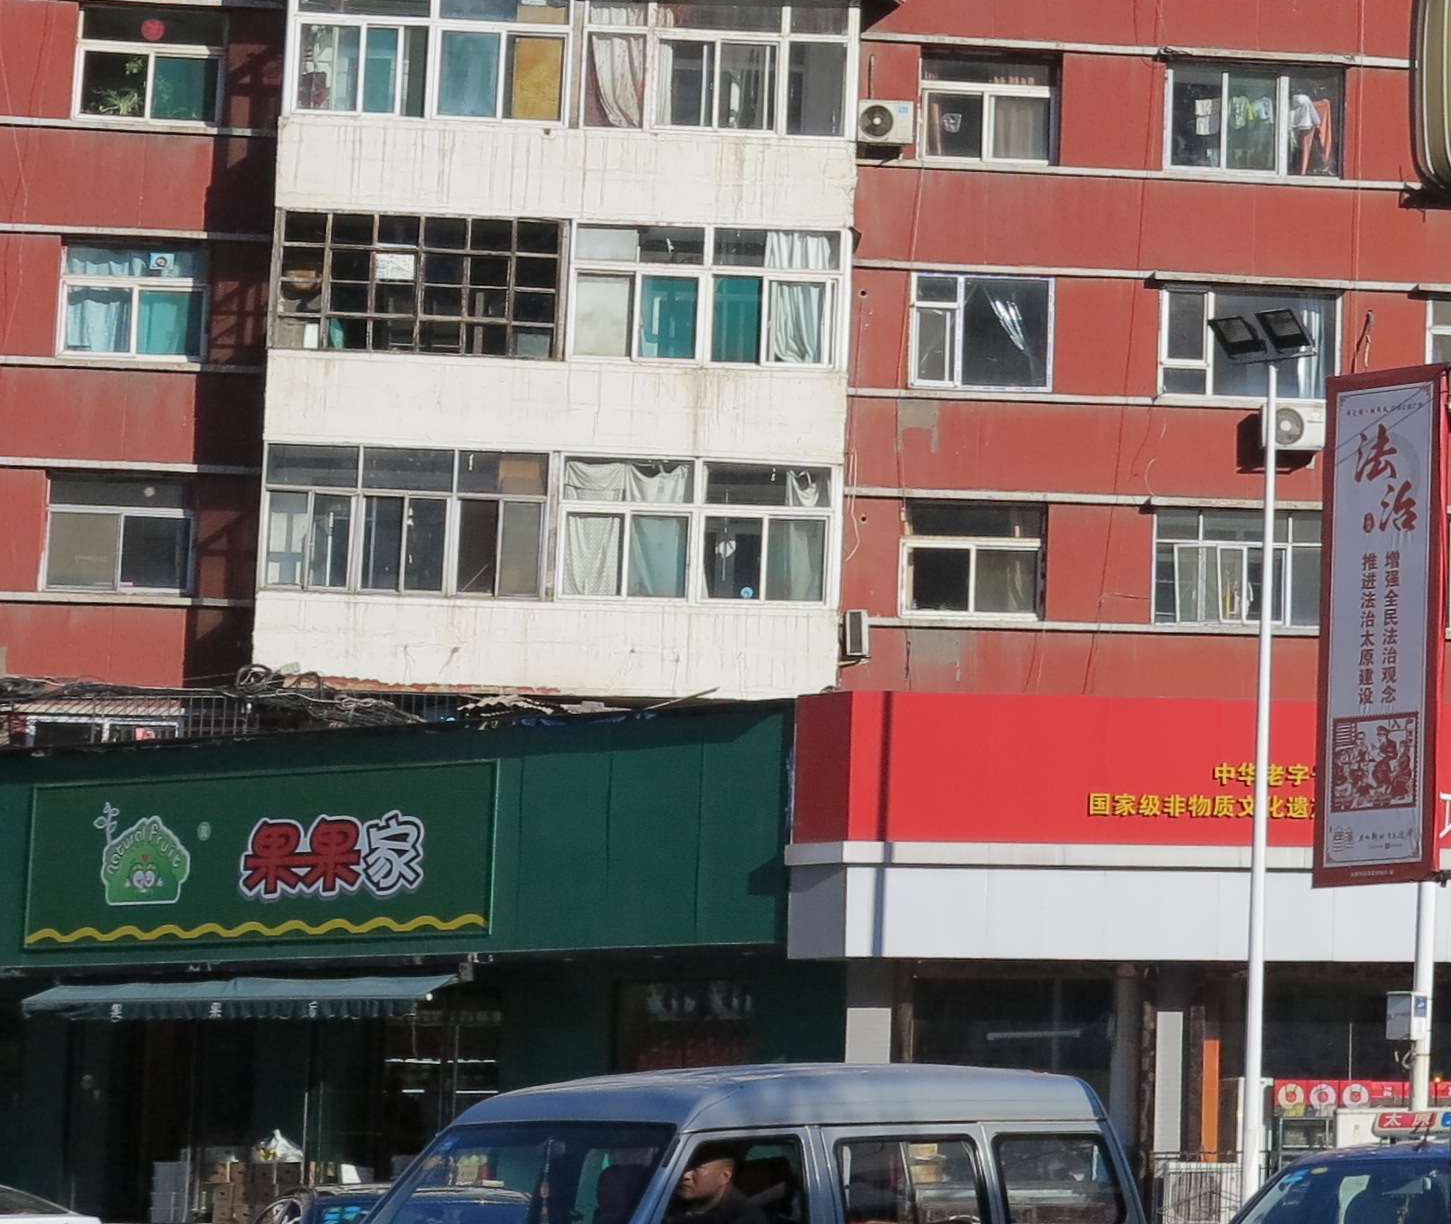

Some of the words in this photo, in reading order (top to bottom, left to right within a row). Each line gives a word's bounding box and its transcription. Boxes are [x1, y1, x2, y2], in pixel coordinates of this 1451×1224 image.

[1354, 423, 1417, 531] 法治
[1358, 553, 1378, 705] 推进法治太原建设
[1381, 550, 1401, 704] 增强全民法治观念
[1089, 792, 1316, 819] 国家级非物质文化遗
[1214, 762, 1316, 786] 中华老字
[243, 810, 424, 897] 果果家
[1383, 1113, 1431, 1127] 太原
